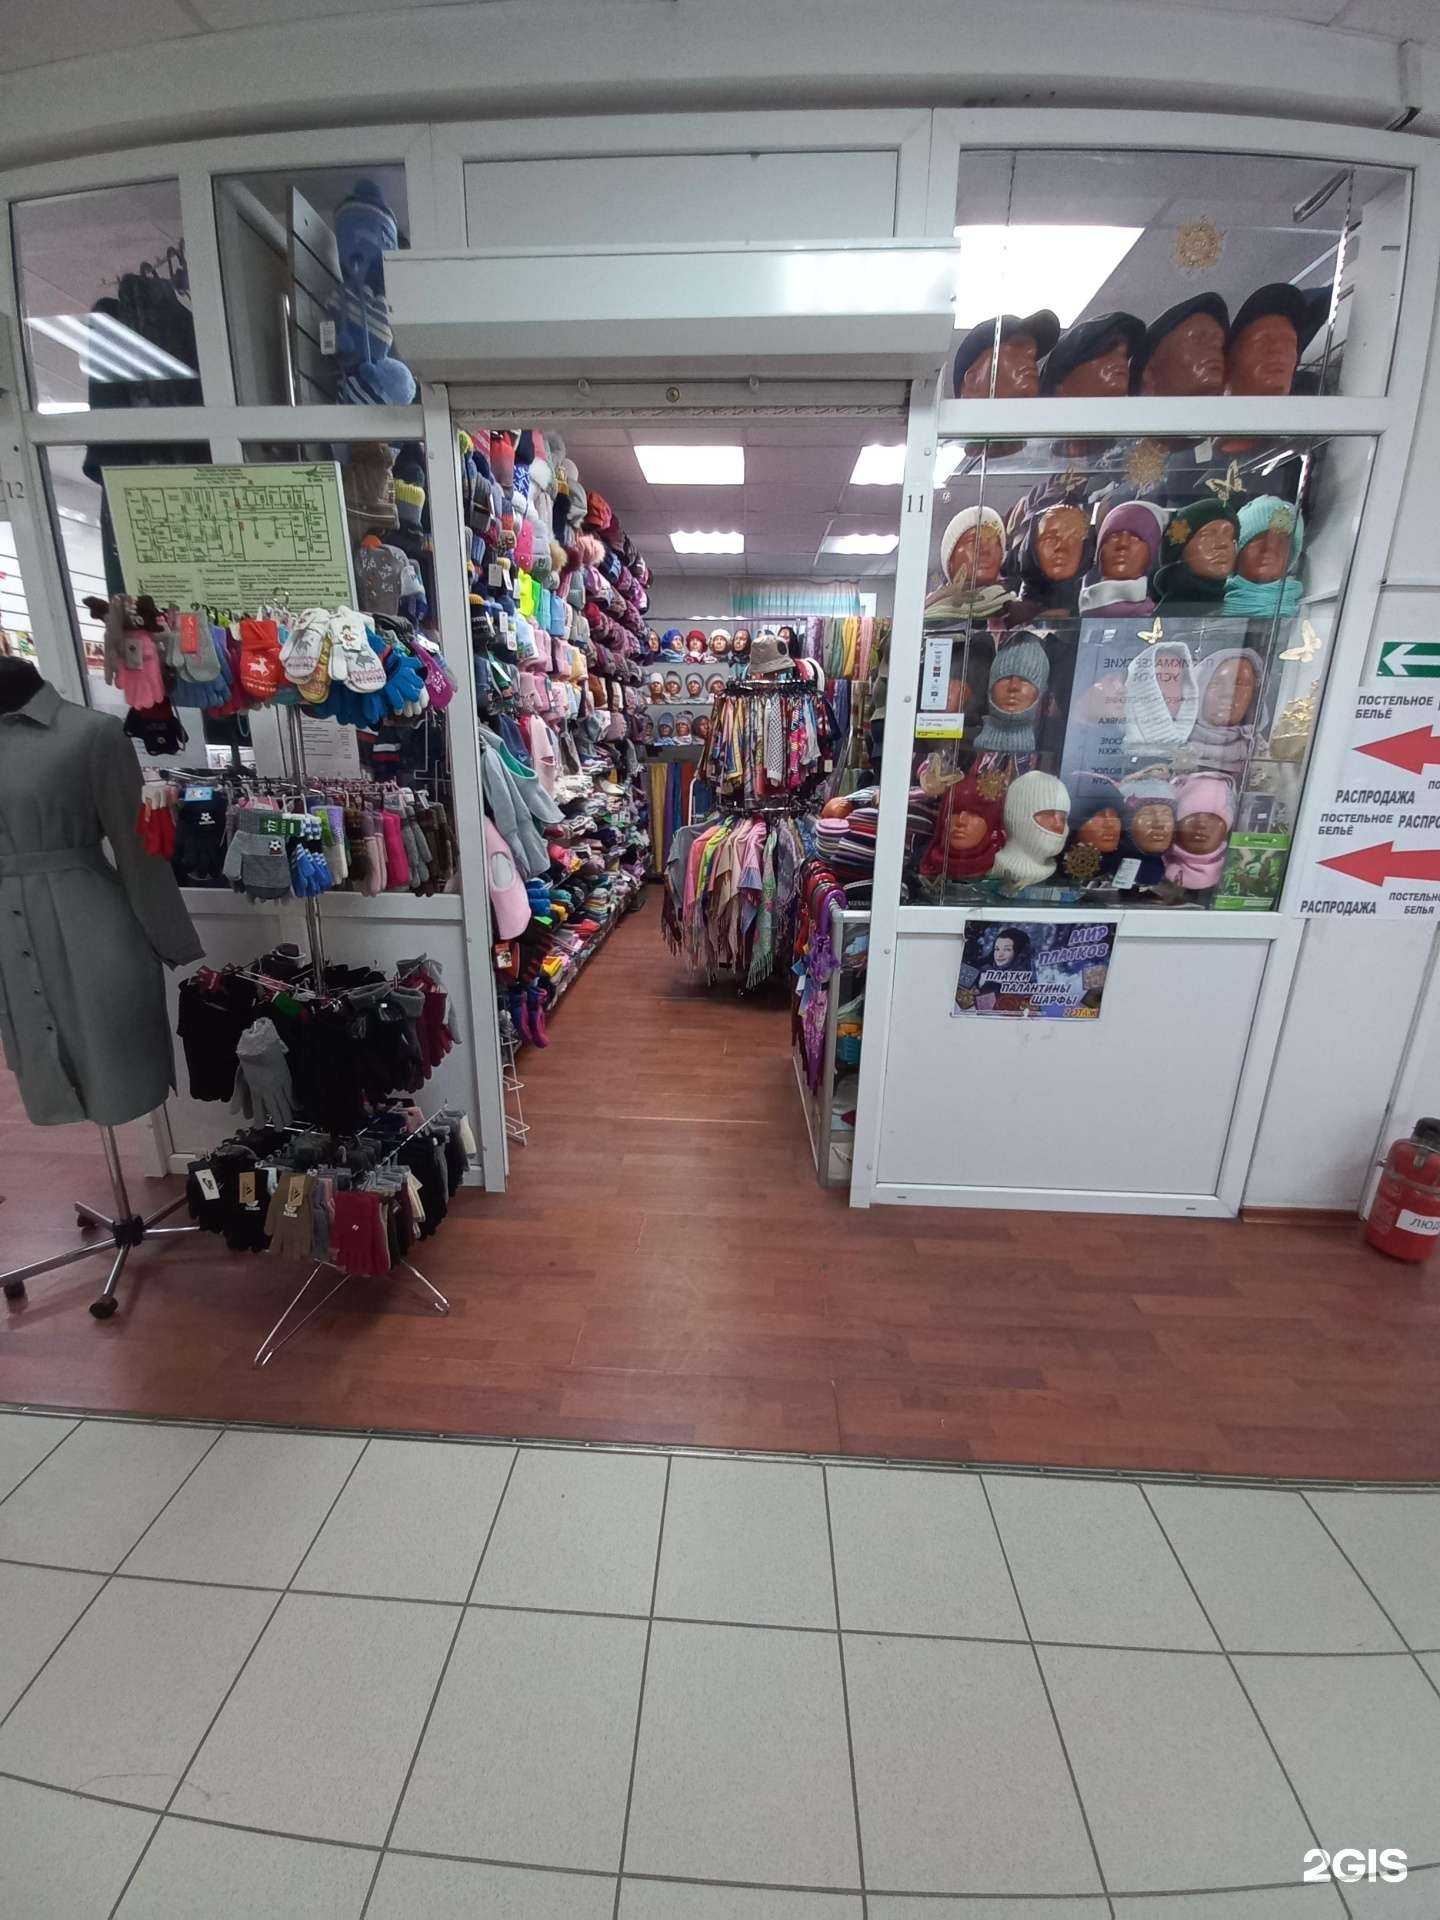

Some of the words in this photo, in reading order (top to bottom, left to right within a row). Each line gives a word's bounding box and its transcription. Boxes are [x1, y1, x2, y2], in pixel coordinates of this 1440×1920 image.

[6, 481, 24, 499] 12
[907, 494, 924, 513] 11
[1358, 695, 1433, 706] ПОСТЕЛЬНОЕ
[1335, 789, 1415, 806] РАСПРОДАЖА
[1320, 813, 1394, 823] ПОСТЕЛЬНОЕ
[1299, 900, 1376, 916] РАСПРОДАЖА
[1404, 905, 1435, 915] БЕЛЬЯ
[1068, 925, 1109, 946] МИР
[1038, 943, 1109, 965] ПЛАТКОВ
[985, 969, 1032, 982] ПЛАТКИ
[1000, 982, 1072, 995] ПАЛАНТИНЫ
[1030, 994, 1077, 1006] ШАРФЫ
